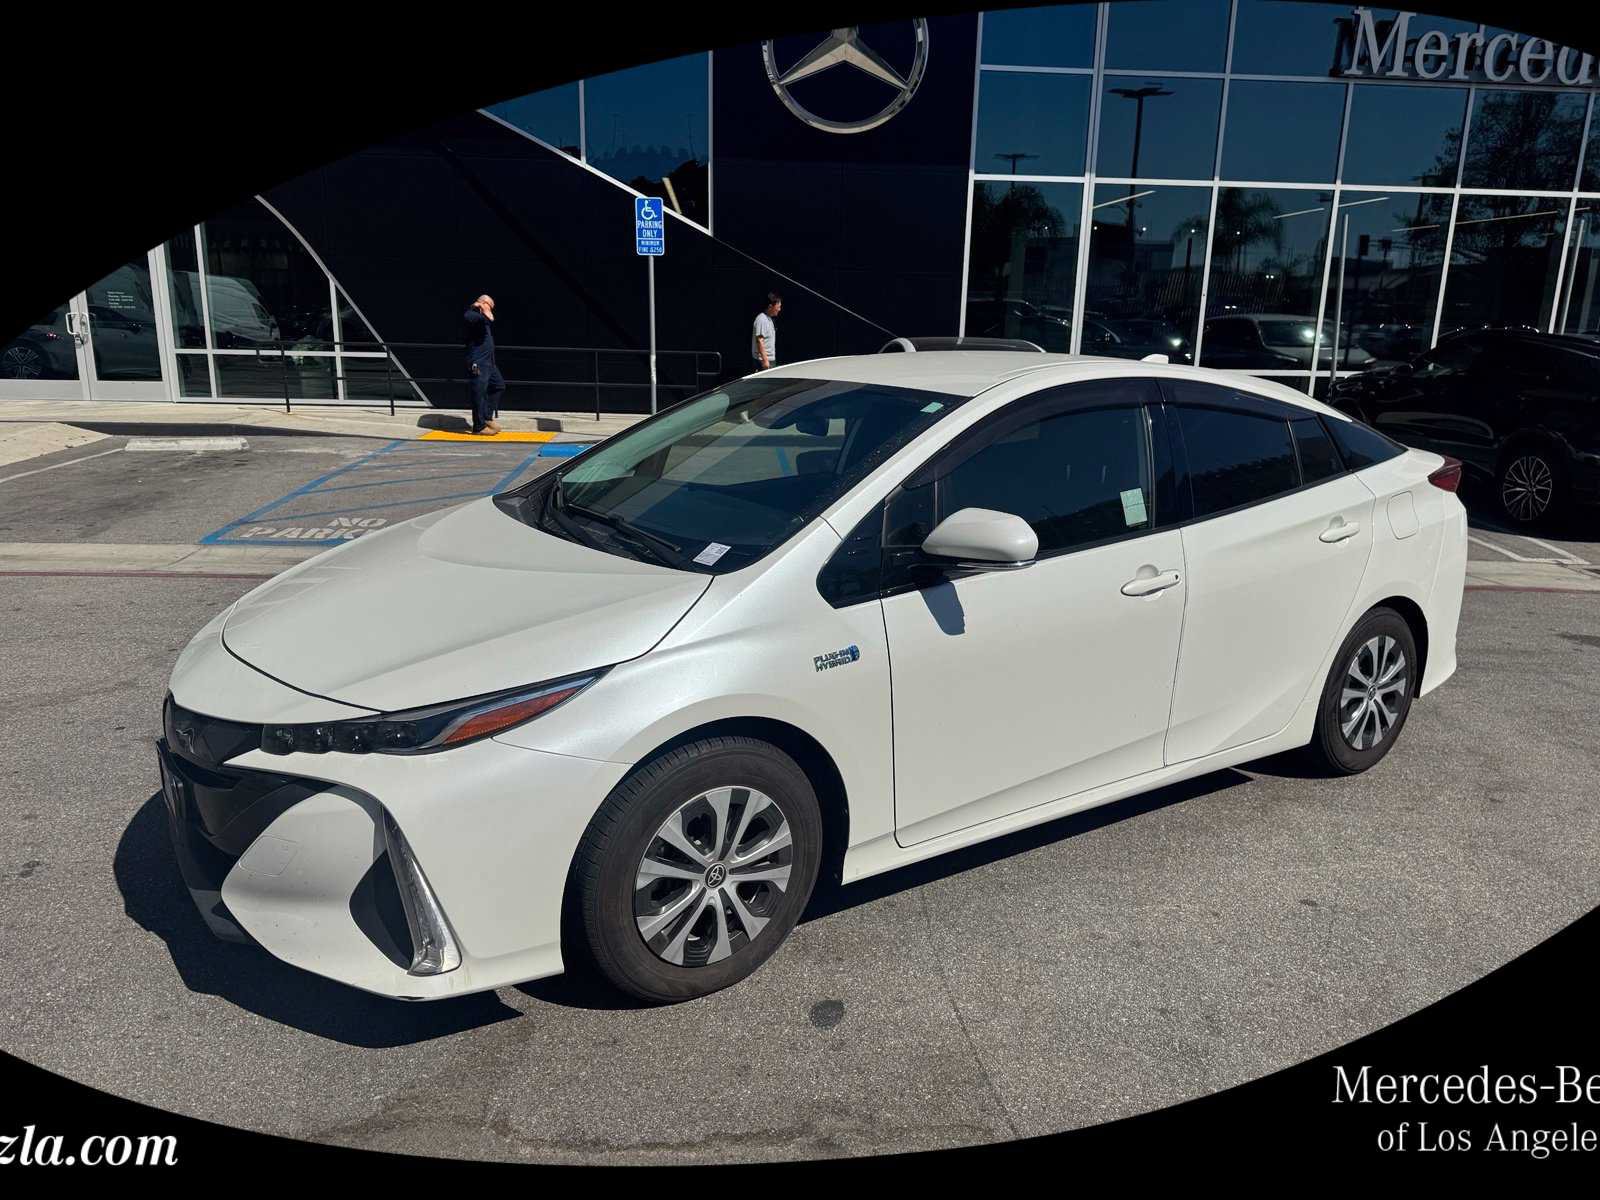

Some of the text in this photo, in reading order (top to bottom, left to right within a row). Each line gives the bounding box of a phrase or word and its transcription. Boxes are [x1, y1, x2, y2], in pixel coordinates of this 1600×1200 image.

[1344, 6, 1600, 85] Merced
[637, 220, 663, 229] PARKING
[642, 230, 658, 238] ONLY
[328, 517, 388, 527] NO
[240, 526, 374, 540] PARK
